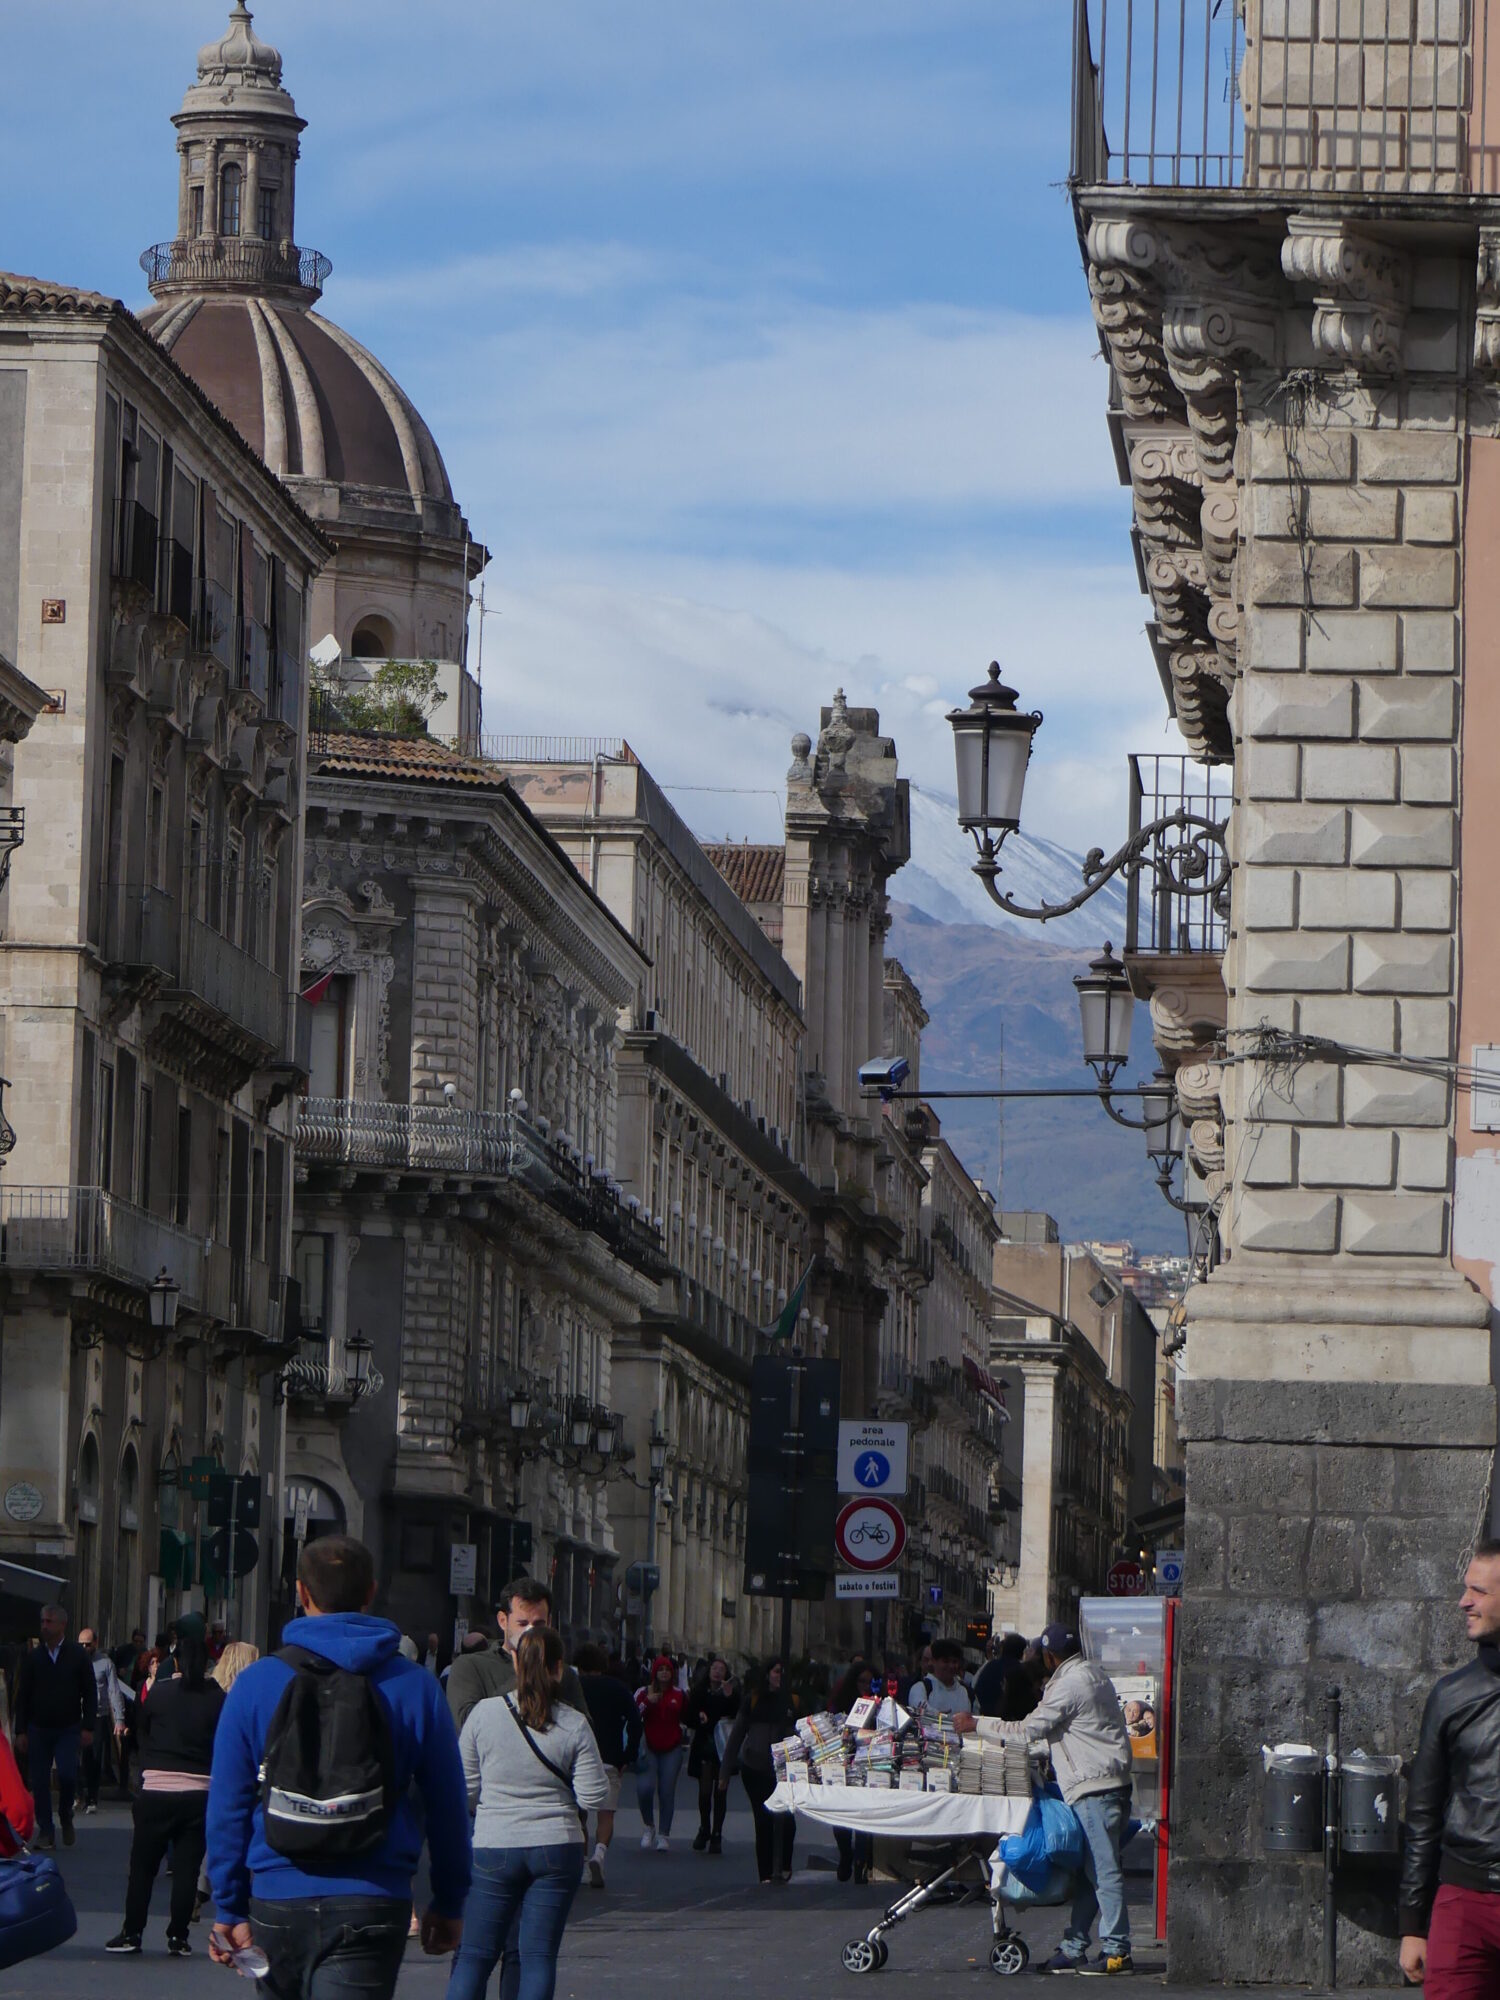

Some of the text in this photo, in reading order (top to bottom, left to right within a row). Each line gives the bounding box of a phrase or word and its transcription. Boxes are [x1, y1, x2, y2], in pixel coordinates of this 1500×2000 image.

[1491, 1099, 1500, 1109] D
[850, 1437, 895, 1447] pedonale
[839, 1581, 863, 1591] sabato
[872, 1580, 896, 1591] festivi
[1110, 1574, 1143, 1589] STOP
[931, 1587, 942, 1601] T
